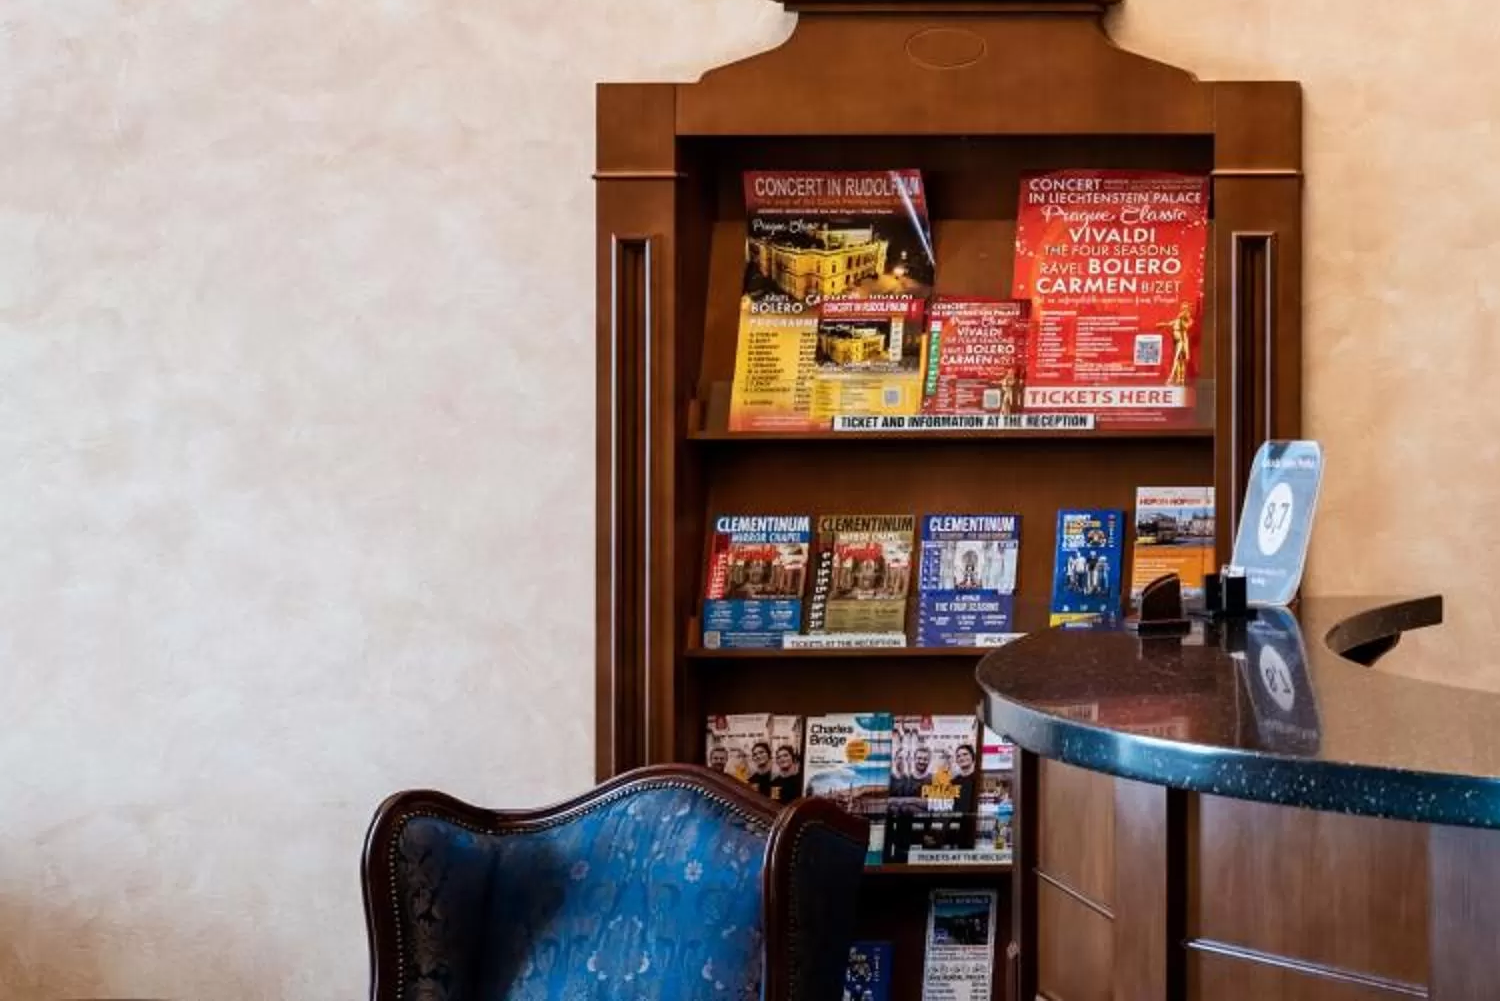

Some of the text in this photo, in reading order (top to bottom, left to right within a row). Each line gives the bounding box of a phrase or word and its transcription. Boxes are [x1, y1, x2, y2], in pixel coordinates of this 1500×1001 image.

[754, 177, 823, 197] CONCERT
[827, 177, 841, 197] IN
[1029, 178, 1102, 192] CONCERT
[1029, 192, 1201, 204] IN LIECHTENSTEIN PALACE
[1041, 204, 1187, 229] Prague Classic
[1068, 227, 1156, 243] VIVALDI
[1044, 245, 1180, 256] THE FOUR SEASONS
[1039, 258, 1182, 275] RAVEL BOLERO
[1036, 278, 1184, 295] CARMEN BIZET
[751, 302, 804, 314] BOLERO
[966, 344, 1016, 355] BOLERO
[941, 354, 993, 366] CARMEN
[1029, 390, 1174, 405] TICKETS HERE
[841, 416, 879, 428] TICKET
[881, 416, 905, 428] AND
[907, 416, 984, 428] INFORMATION
[986, 416, 1001, 428] AT
[1003, 416, 1021, 428] THE
[1025, 415, 1088, 428] RECEPTION
[717, 516, 811, 533] CLEMENTINUM
[820, 516, 914, 533] CLEMENTINUM
[929, 516, 1016, 533] CLEMENTINUM
[1262, 502, 1291, 534] 8,7
[810, 723, 854, 734] Charles
[810, 734, 847, 747] Bridge
